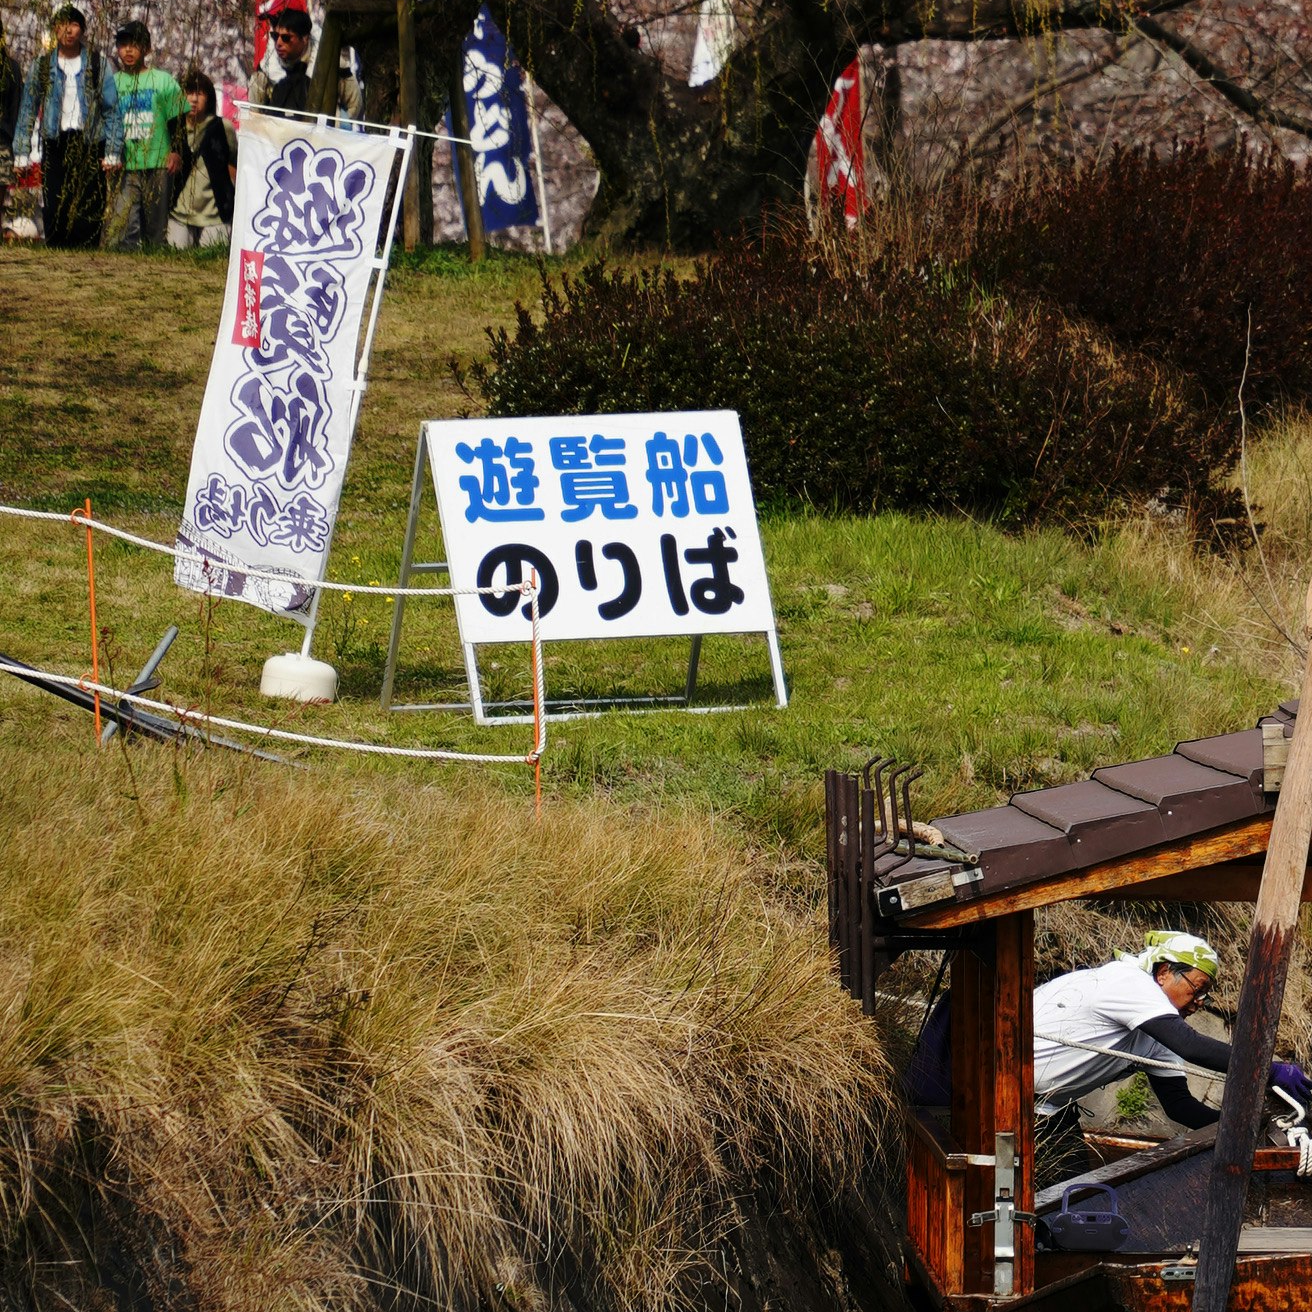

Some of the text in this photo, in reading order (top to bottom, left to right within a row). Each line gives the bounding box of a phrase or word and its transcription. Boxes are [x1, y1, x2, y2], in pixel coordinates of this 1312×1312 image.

[463, 13, 527, 207] うどん
[455, 431, 730, 523] 遊覧船
[476, 526, 745, 622] のりば
